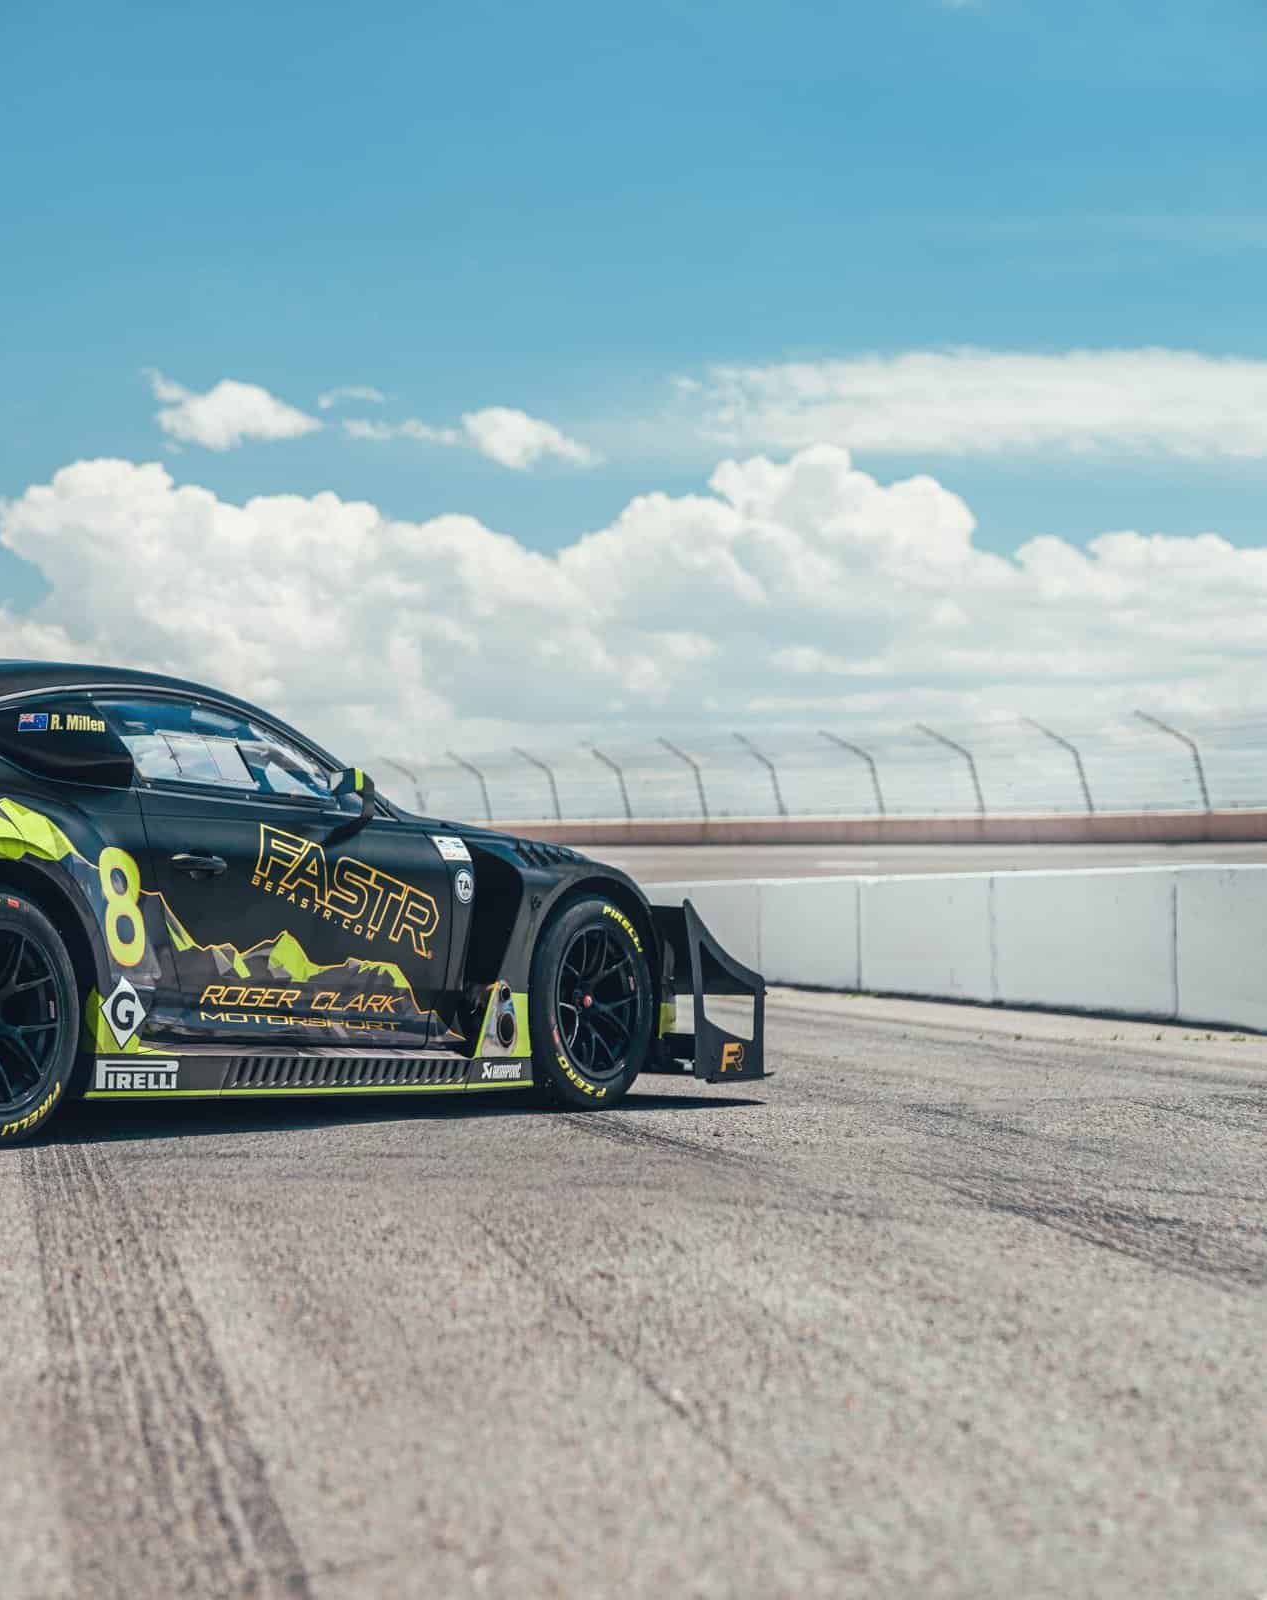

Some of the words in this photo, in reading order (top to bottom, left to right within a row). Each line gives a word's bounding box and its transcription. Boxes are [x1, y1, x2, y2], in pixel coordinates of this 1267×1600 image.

[50, 714, 63, 730] R.
[66, 714, 106, 732] Millen
[98, 846, 146, 967] 8
[251, 874, 376, 941] BEFASTR.COM
[255, 823, 440, 958] FASTR
[111, 991, 135, 1031] G
[200, 985, 301, 1009] ROGER
[311, 991, 406, 1013] CLARK
[95, 1060, 180, 1089] PIRELLI
